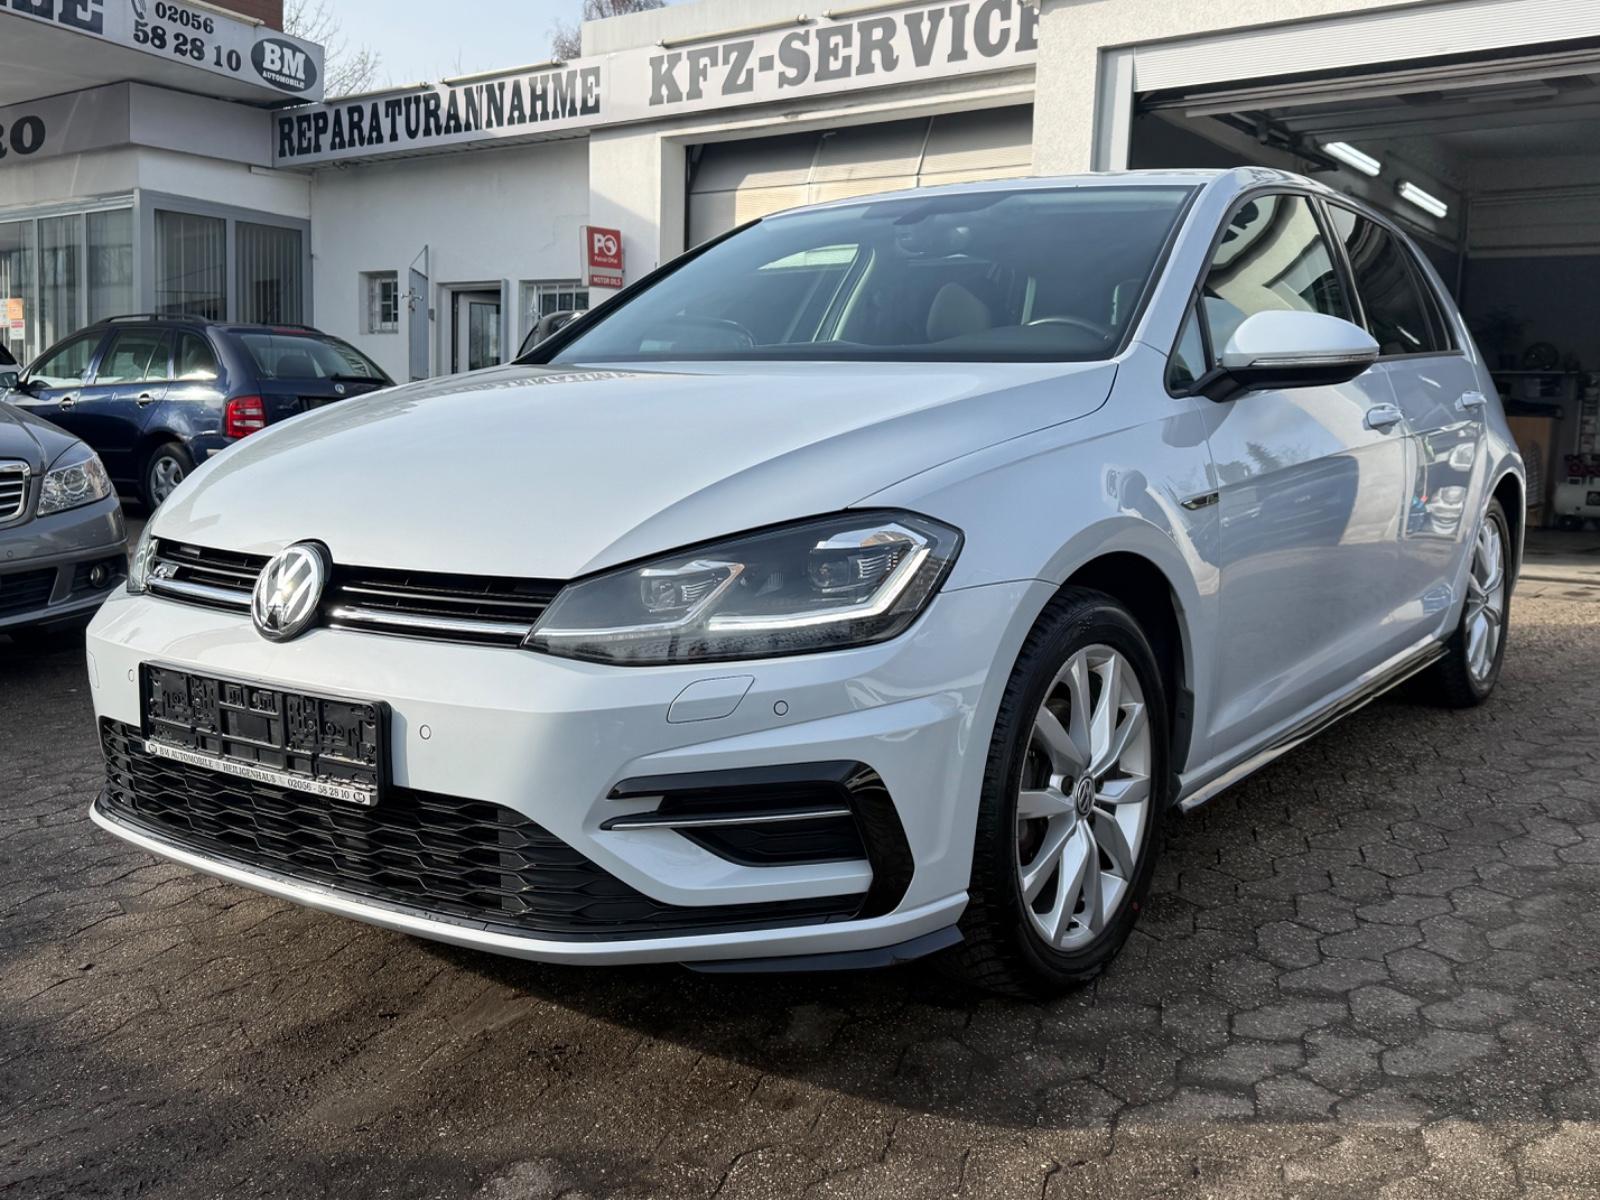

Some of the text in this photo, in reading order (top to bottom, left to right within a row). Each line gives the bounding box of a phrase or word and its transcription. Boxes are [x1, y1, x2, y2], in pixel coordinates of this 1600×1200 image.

[155, 1, 214, 35] 02056
[133, 20, 242, 72] 58 28 10
[262, 41, 306, 81] BM
[262, 70, 305, 89] AUTOMOBILE
[278, 66, 601, 158] REPARATURANNAHME
[171, 748, 214, 769] AUTOMOBILE
[287, 778, 312, 792] 02056
[317, 784, 328, 795] 58
[328, 787, 340, 798] 28
[341, 789, 350, 800] 10
